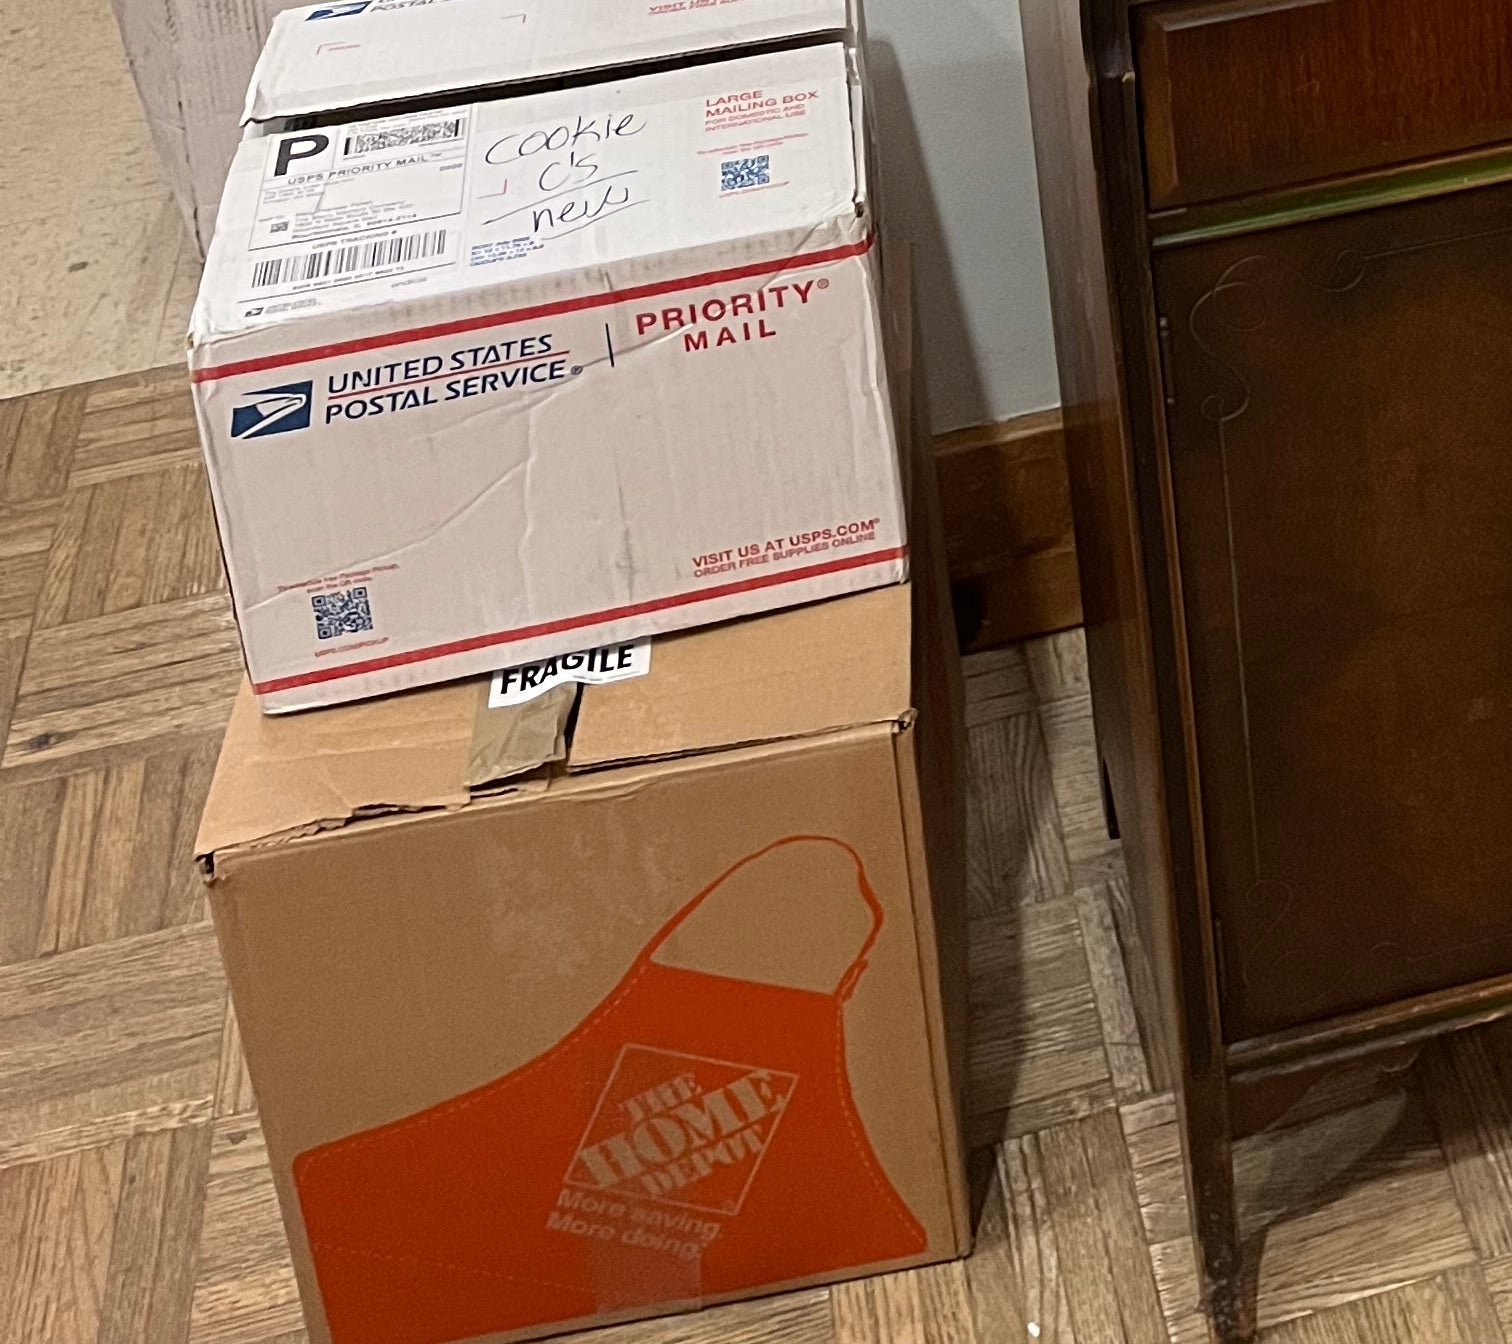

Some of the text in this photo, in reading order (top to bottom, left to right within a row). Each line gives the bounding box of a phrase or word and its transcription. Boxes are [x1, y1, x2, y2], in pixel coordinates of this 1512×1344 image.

[705, 90, 819, 118] MAILING BOX
[706, 89, 763, 107] LARGE
[273, 133, 330, 178] P
[287, 172, 324, 186] USPS
[327, 161, 393, 180] PRIORITY
[682, 317, 778, 354] MAIL
[327, 332, 554, 395] UNITED STATES
[324, 386, 440, 425] POSTAL
[691, 549, 734, 568] VISIT
[737, 543, 761, 559] US
[764, 537, 785, 554] AT
[693, 531, 877, 578] ORDER FREE SUPPLIES ONLINE
[500, 644, 635, 695] FRAGILE
[617, 1071, 704, 1122] THE
[577, 1067, 788, 1189] HOME
[640, 1123, 764, 1199] DEPOT
[556, 1187, 627, 1217] More
[545, 1210, 617, 1242] More
